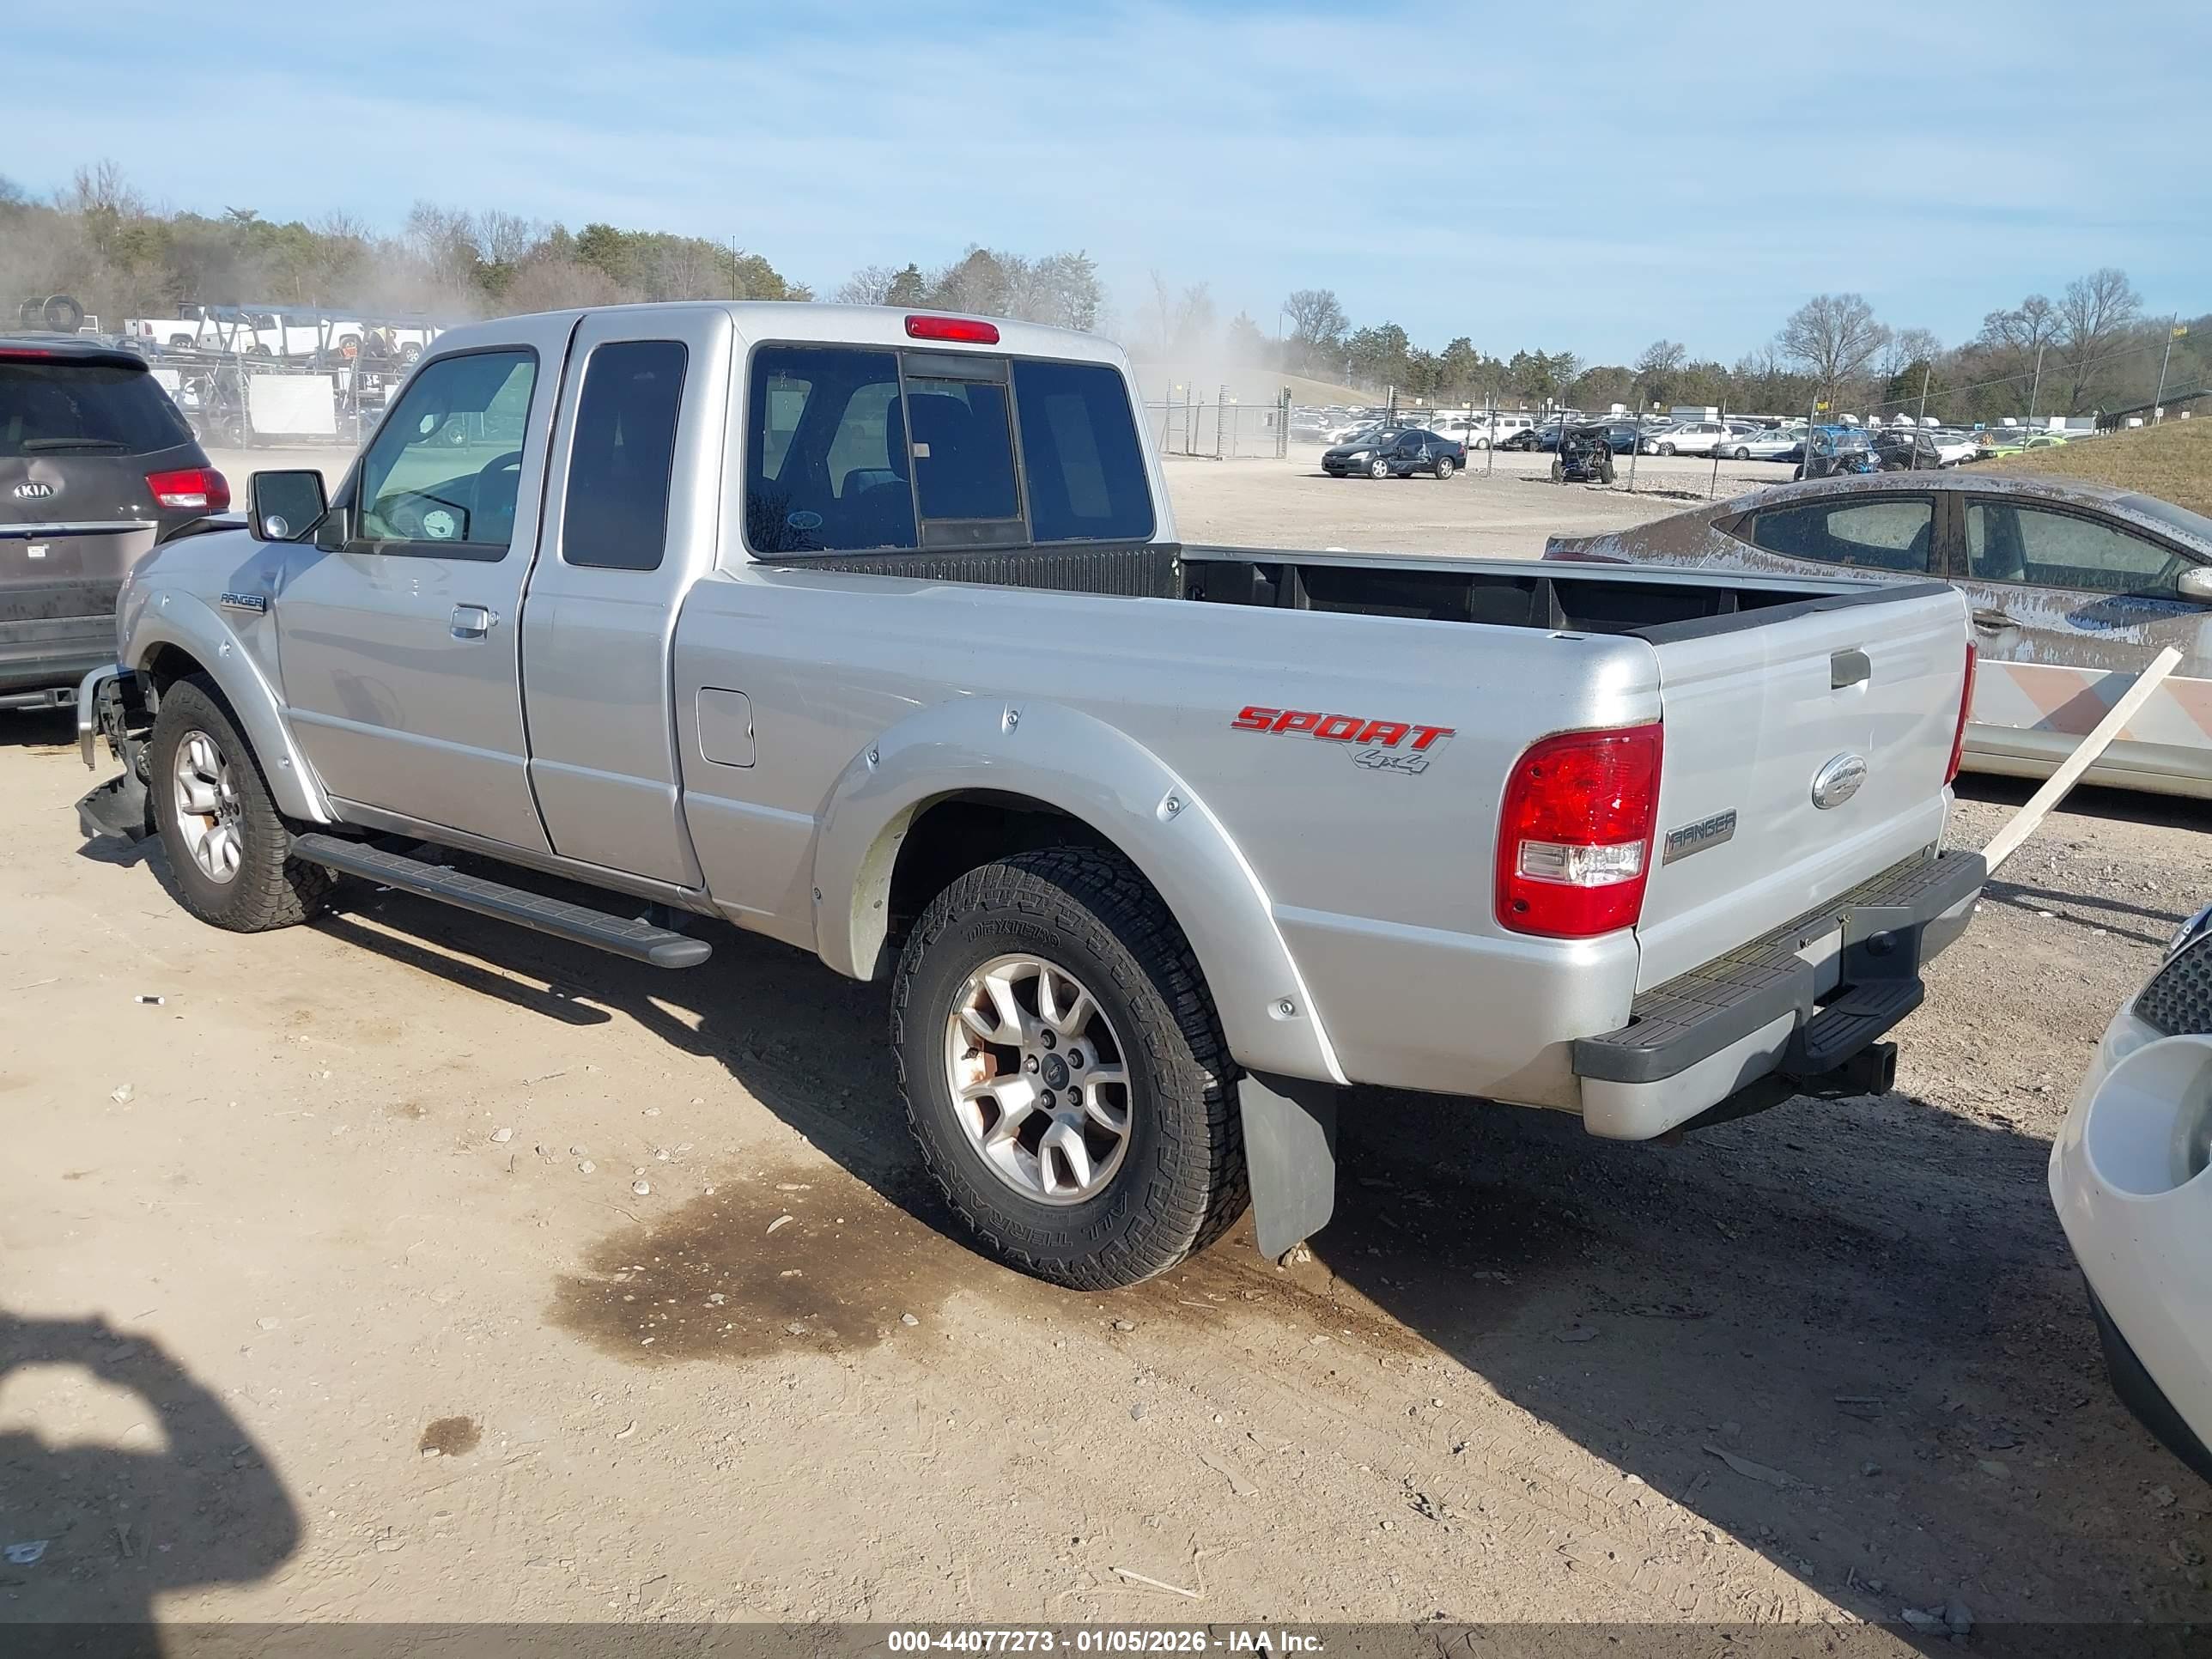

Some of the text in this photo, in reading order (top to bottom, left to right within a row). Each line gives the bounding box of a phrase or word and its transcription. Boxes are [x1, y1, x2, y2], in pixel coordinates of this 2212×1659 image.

[21, 483, 52, 496] KIA
[221, 592, 263, 608] RANGER
[1230, 705, 1456, 752] SPORT
[1669, 810, 1736, 850] RANGER
